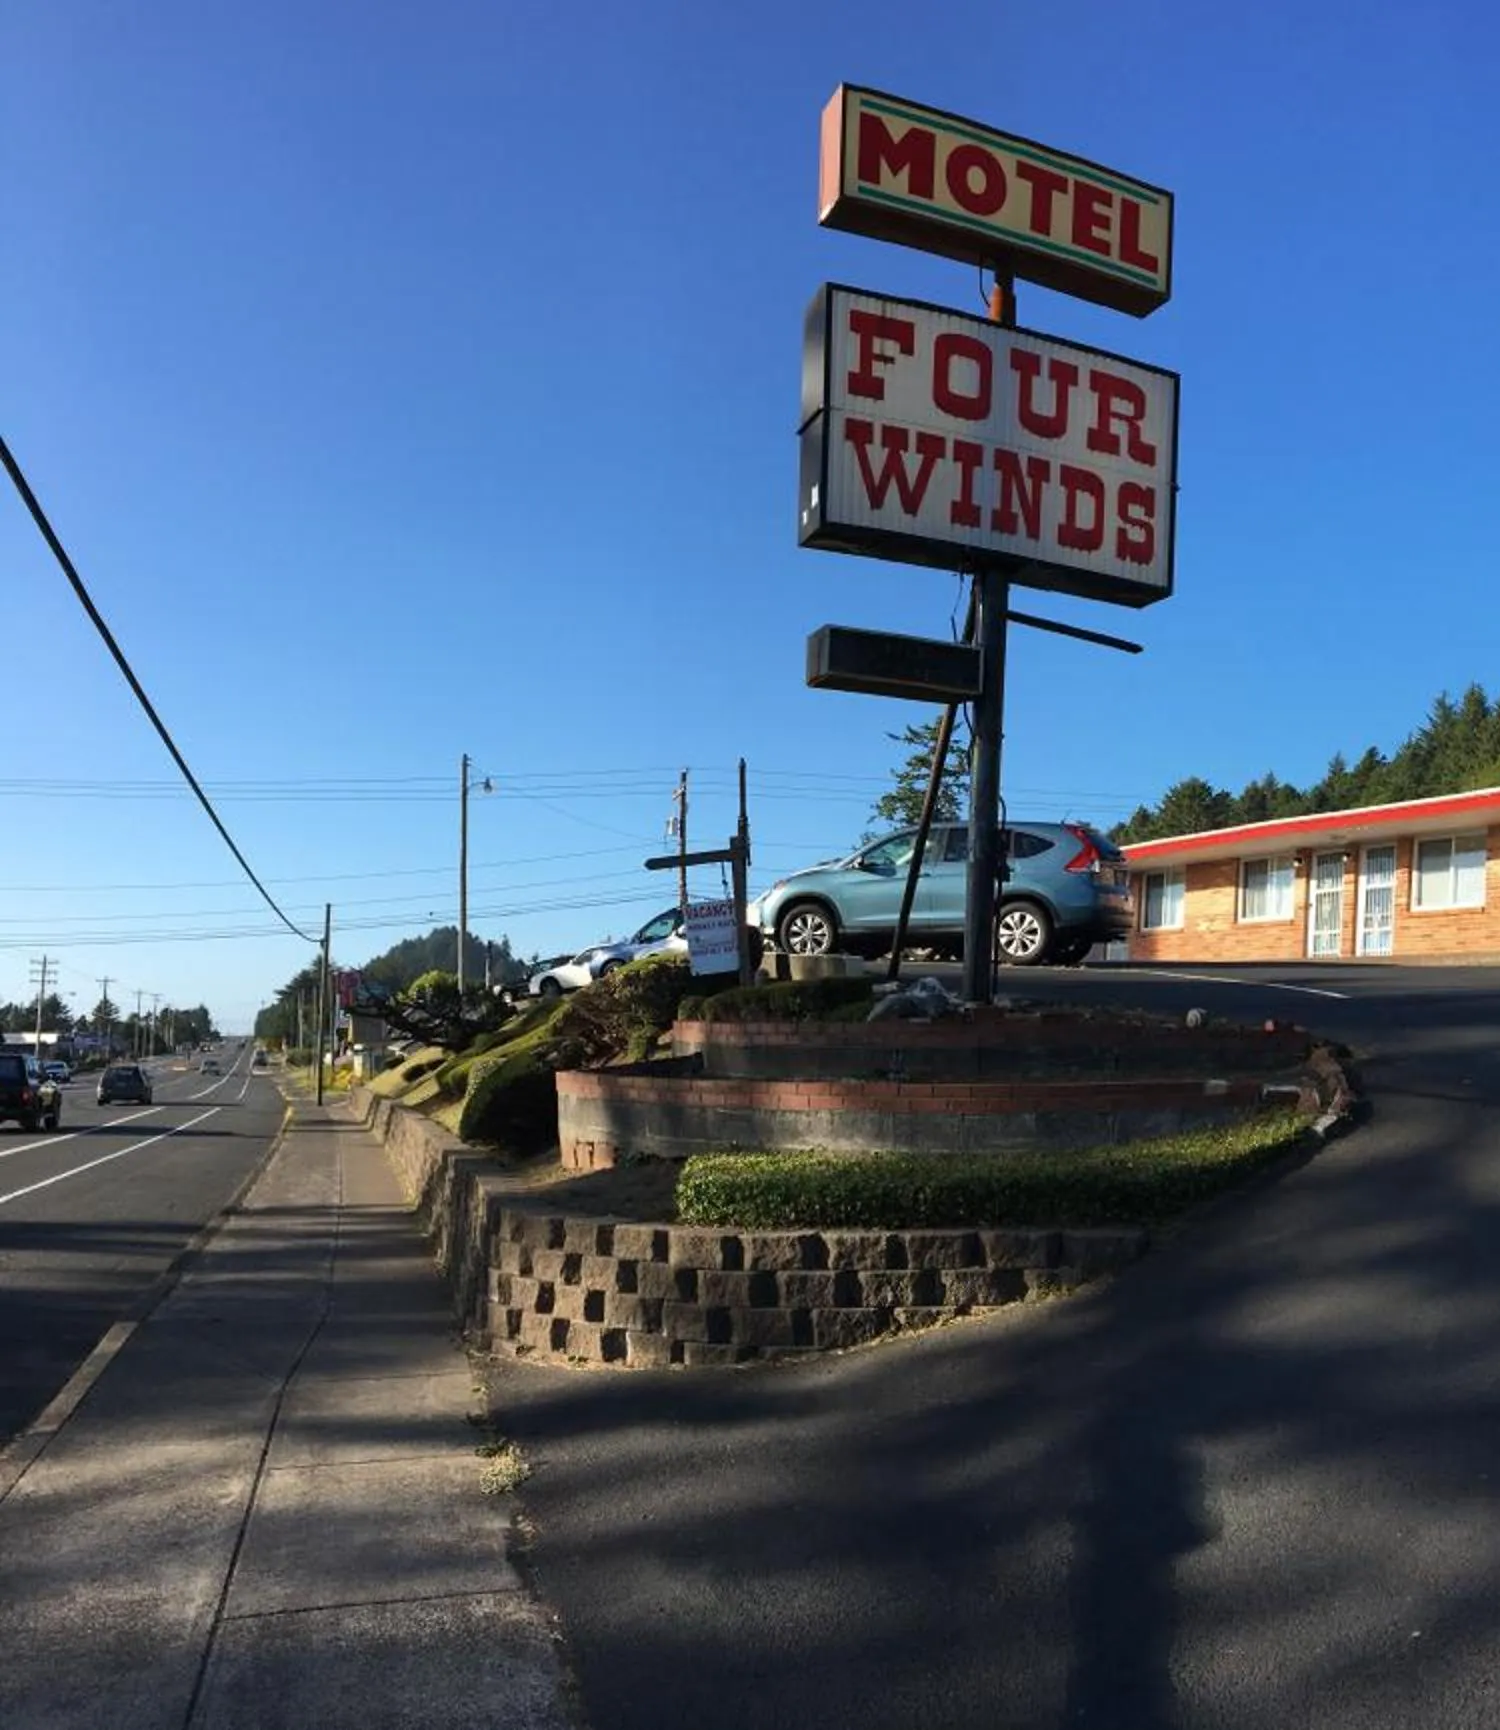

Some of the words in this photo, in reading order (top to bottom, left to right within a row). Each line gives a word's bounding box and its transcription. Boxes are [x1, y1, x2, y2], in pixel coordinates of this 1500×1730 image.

[858, 111, 1159, 273] MOTEL
[848, 309, 1156, 467] FOUR
[845, 417, 1155, 566] WINDS
